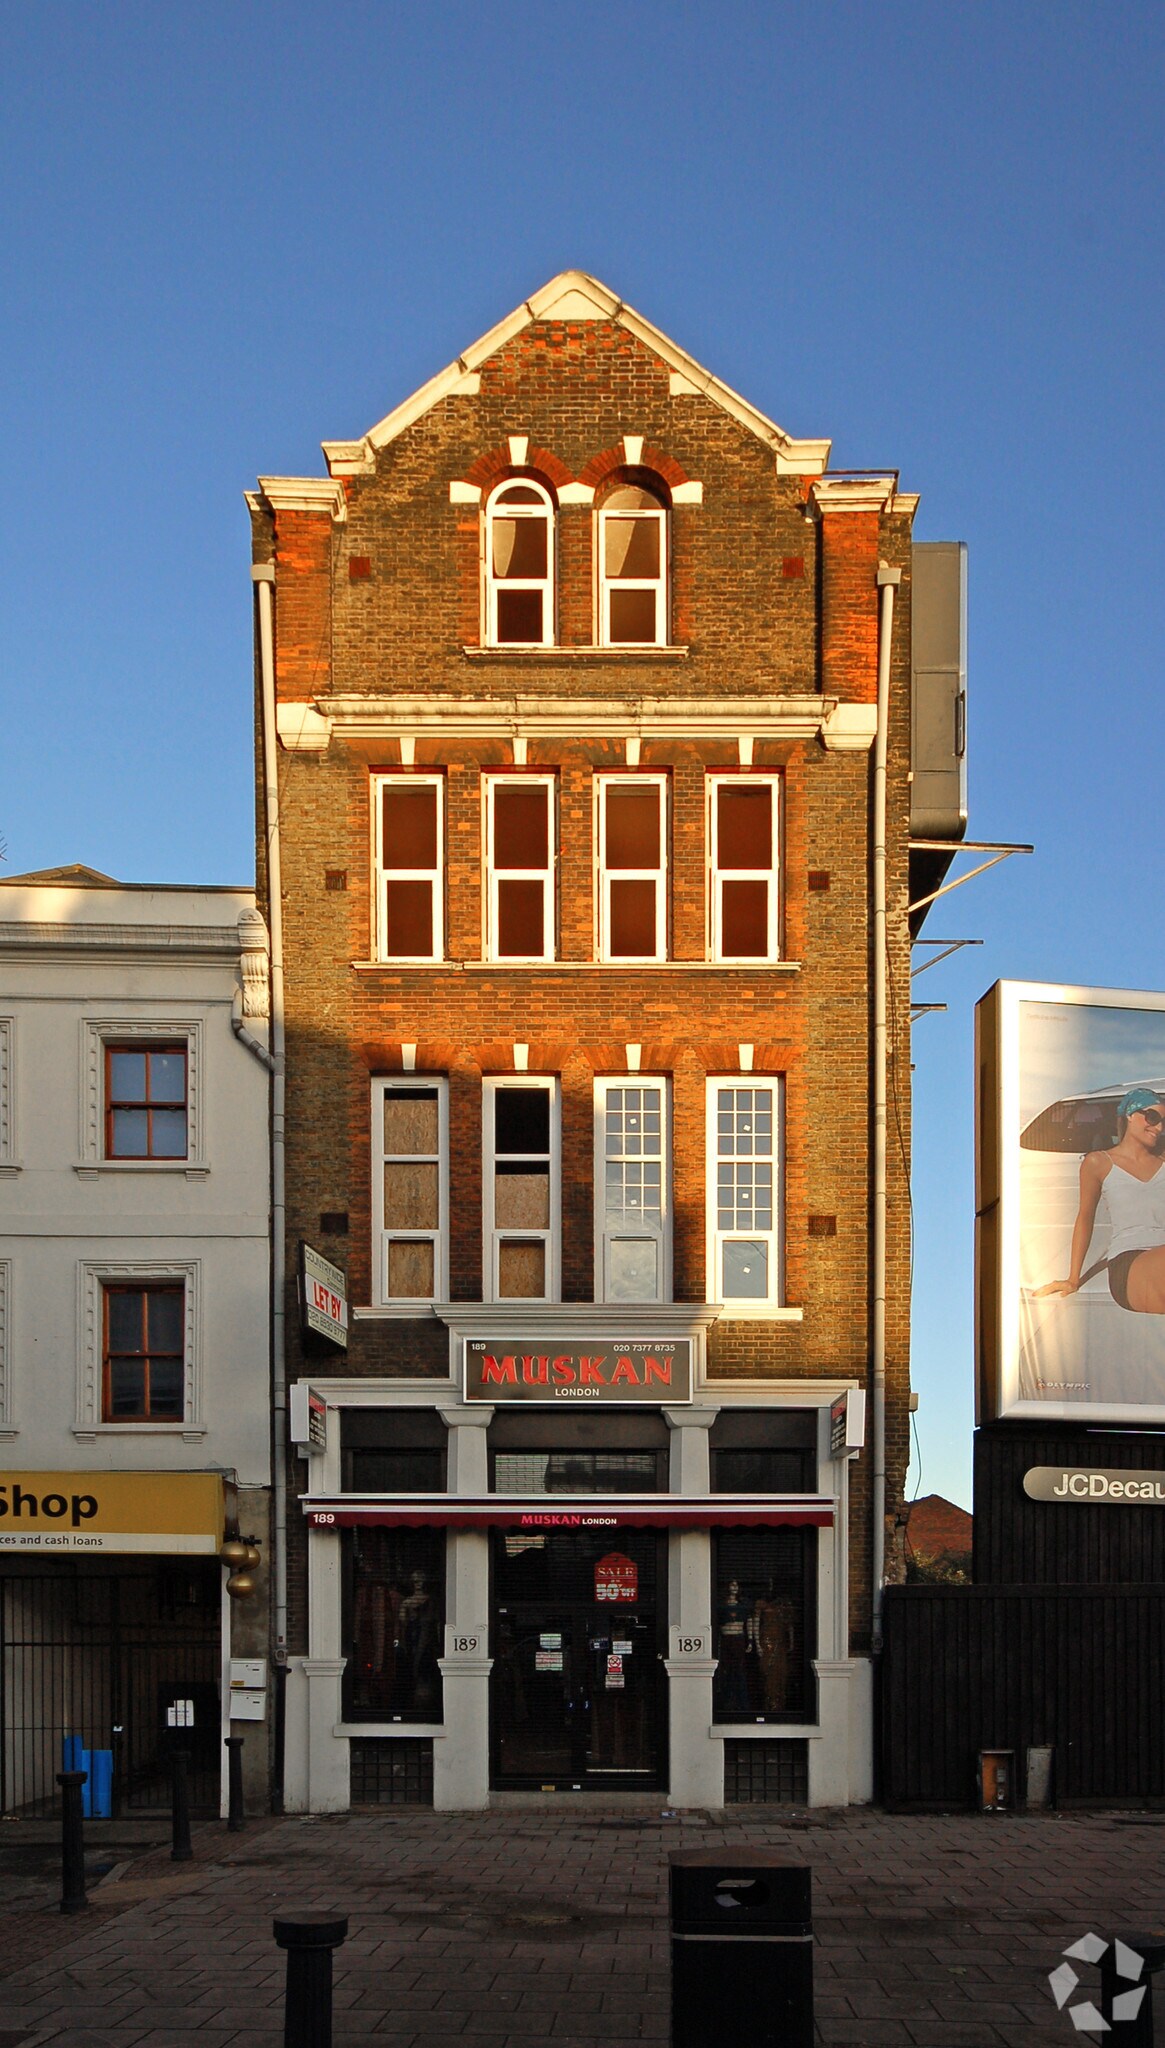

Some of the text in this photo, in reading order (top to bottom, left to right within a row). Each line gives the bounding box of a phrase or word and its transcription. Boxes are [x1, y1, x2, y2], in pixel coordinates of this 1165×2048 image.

[314, 1281, 341, 1322] LET BY
[471, 1343, 486, 1351] 189
[613, 1344, 676, 1352] 020 7377 8735
[480, 1355, 673, 1386] MUSKAN
[555, 1388, 600, 1397] LONDON
[313, 1513, 335, 1523] 189
[521, 1515, 580, 1525] MUSKAN
[20, 1535, 41, 1544] and
[45, 1536, 69, 1545] cash
[73, 1536, 103, 1546] loans
[598, 1567, 634, 1577] SALE
[454, 1637, 477, 1651] 189
[678, 1638, 702, 1652] 189
